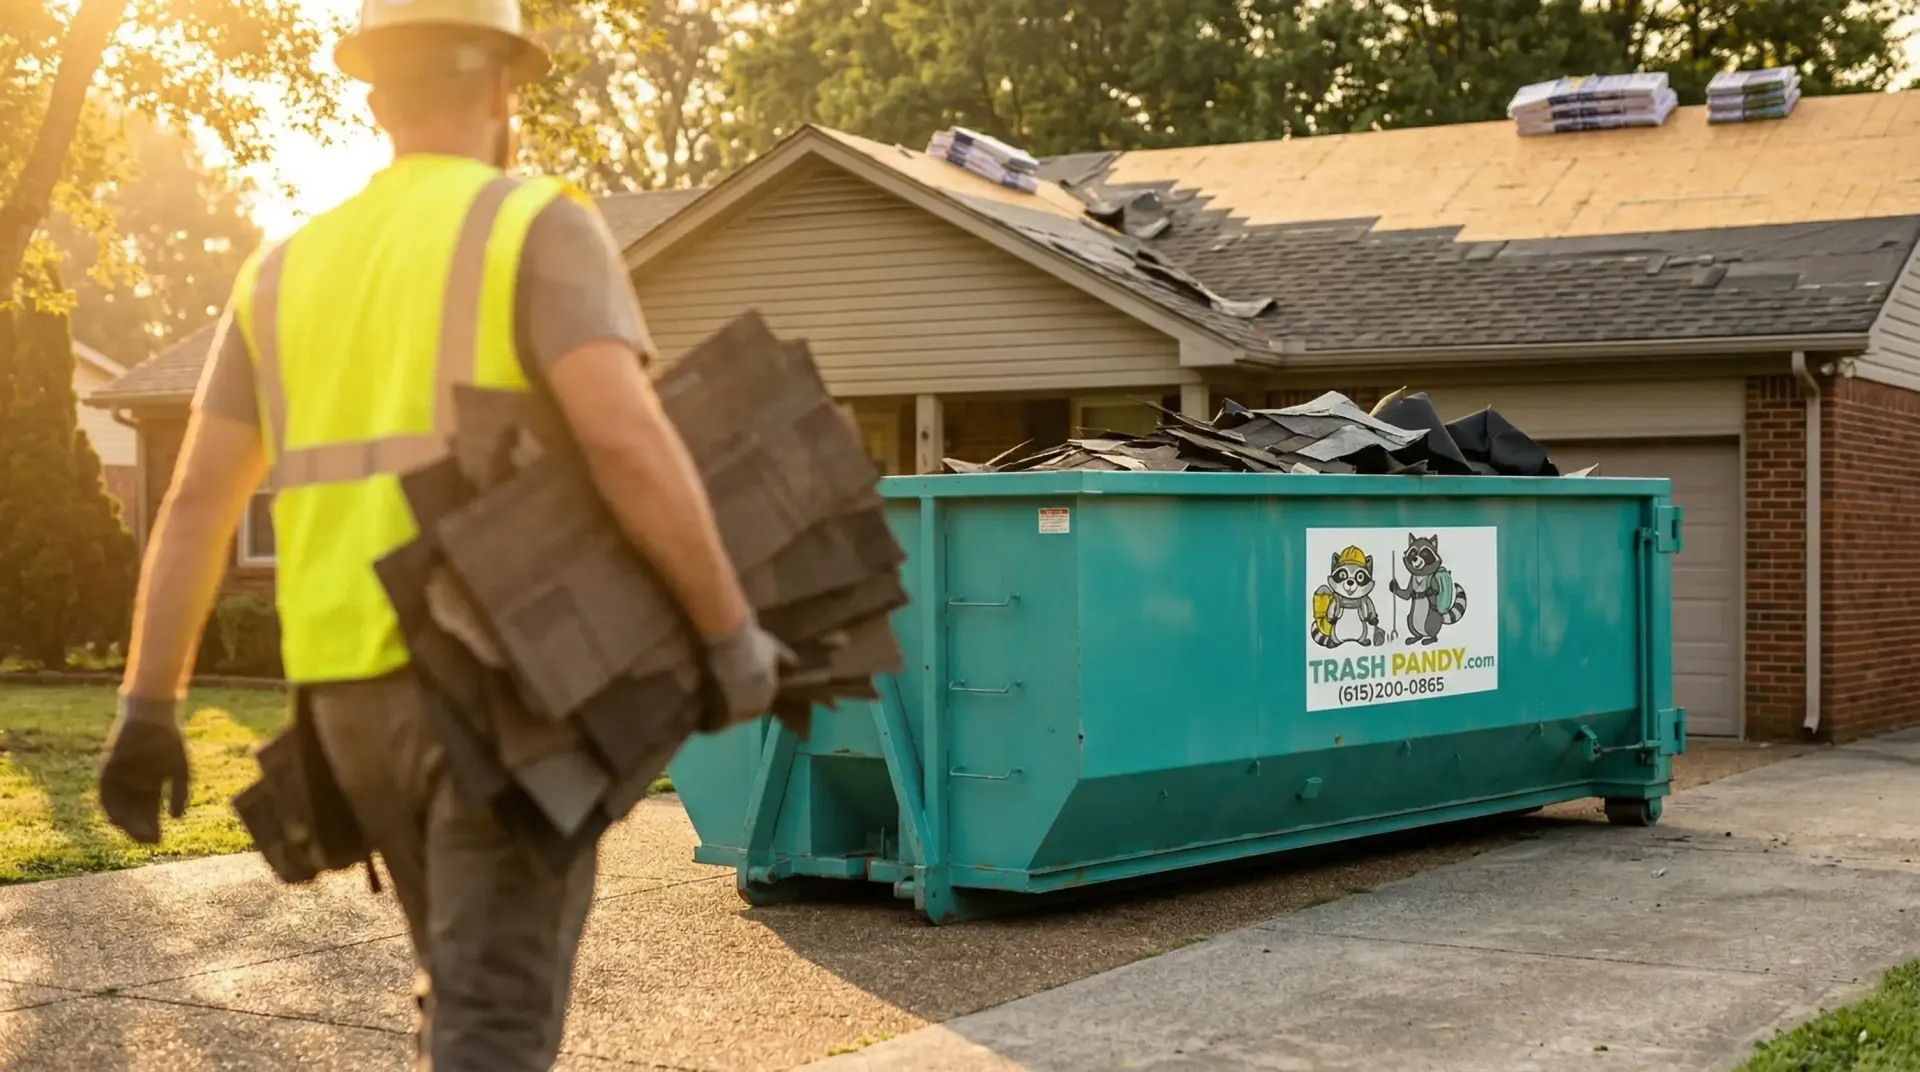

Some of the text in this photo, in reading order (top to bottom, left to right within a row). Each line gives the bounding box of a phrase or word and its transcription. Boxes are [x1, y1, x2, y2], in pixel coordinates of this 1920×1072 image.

[1309, 647, 1495, 684] TRASH PANDY.com
[1338, 677, 1444, 705] (615)200-0865
